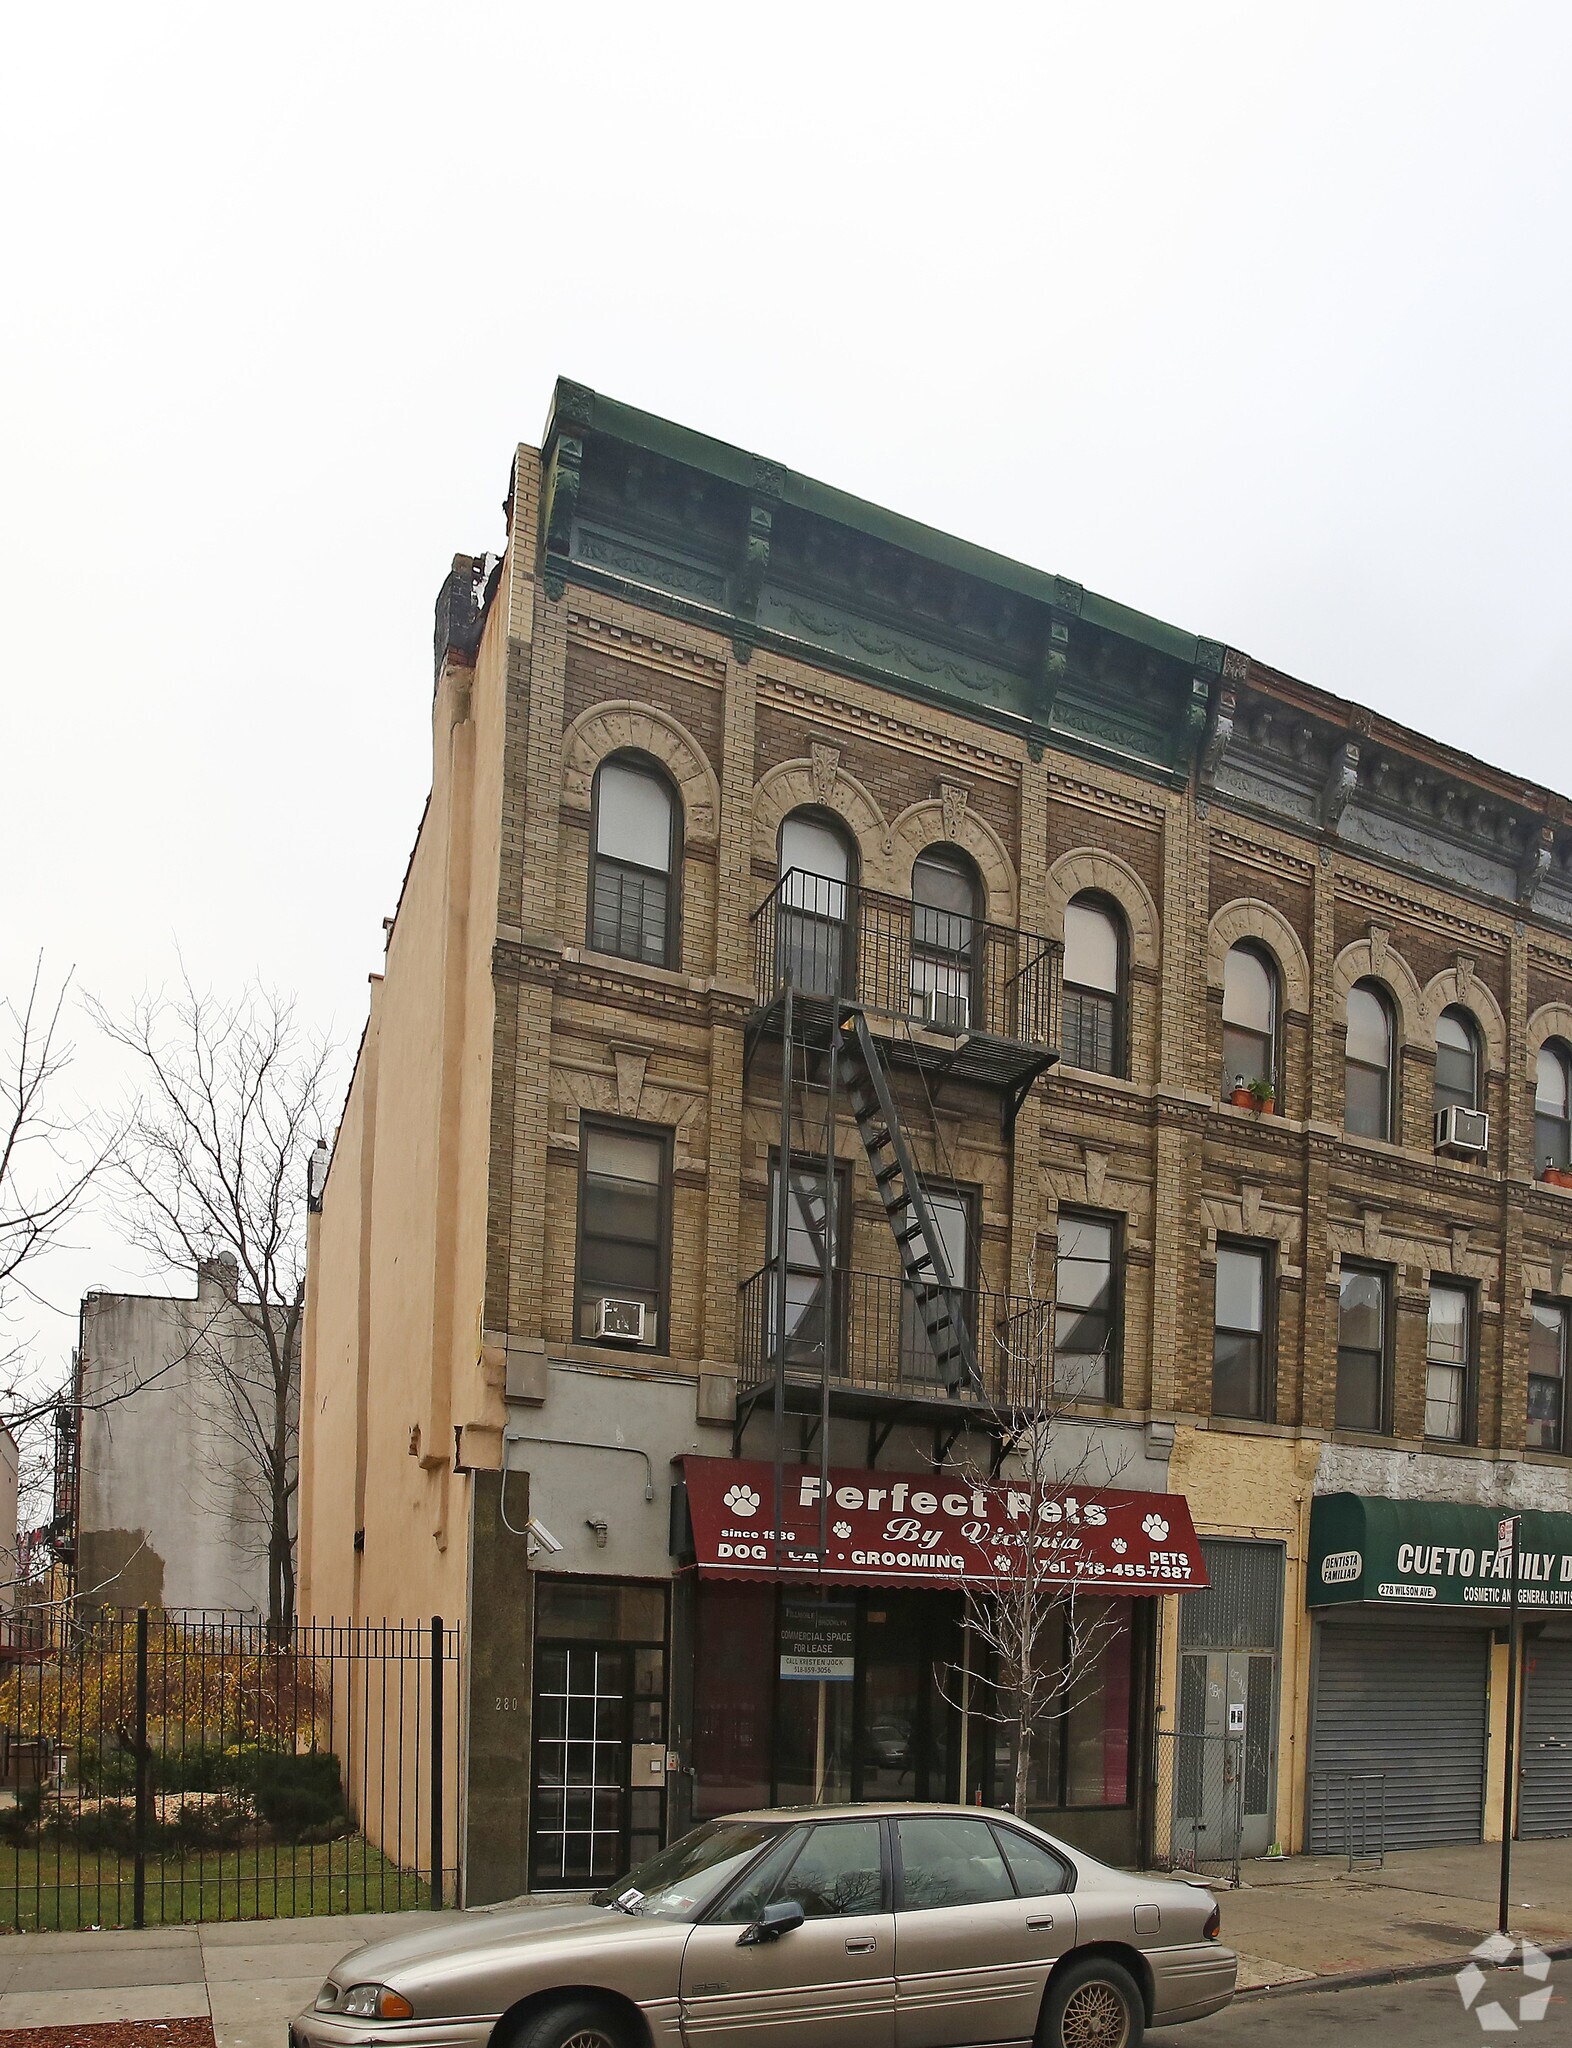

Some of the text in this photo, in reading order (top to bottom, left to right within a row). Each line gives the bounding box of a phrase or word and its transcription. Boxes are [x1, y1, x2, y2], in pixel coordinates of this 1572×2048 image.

[799, 1476, 1109, 1526] Perfect Pets
[721, 1528, 759, 1540] since
[882, 1518, 943, 1549] By
[717, 1543, 965, 1569] DOG CA GROOMING
[1150, 1551, 1189, 1566] PETS
[1325, 1555, 1358, 1569] DENTISTA
[1397, 1543, 1475, 1577] CUETO
[1039, 1559, 1192, 1580] Tel. 718-455-7387
[1323, 1568, 1356, 1581] FAMILIAR
[1380, 1585, 1394, 1595] 278
[1395, 1586, 1419, 1596] WILSON
[1463, 1586, 1500, 1603] COSMETIC
[1501, 1588, 1513, 1603] AN
[1517, 1588, 1549, 1604] GENERAL
[780, 1630, 852, 1642] COMMERCIAL SPACE
[793, 1643, 833, 1653] FOR LEASE
[495, 1697, 518, 1710] 280
